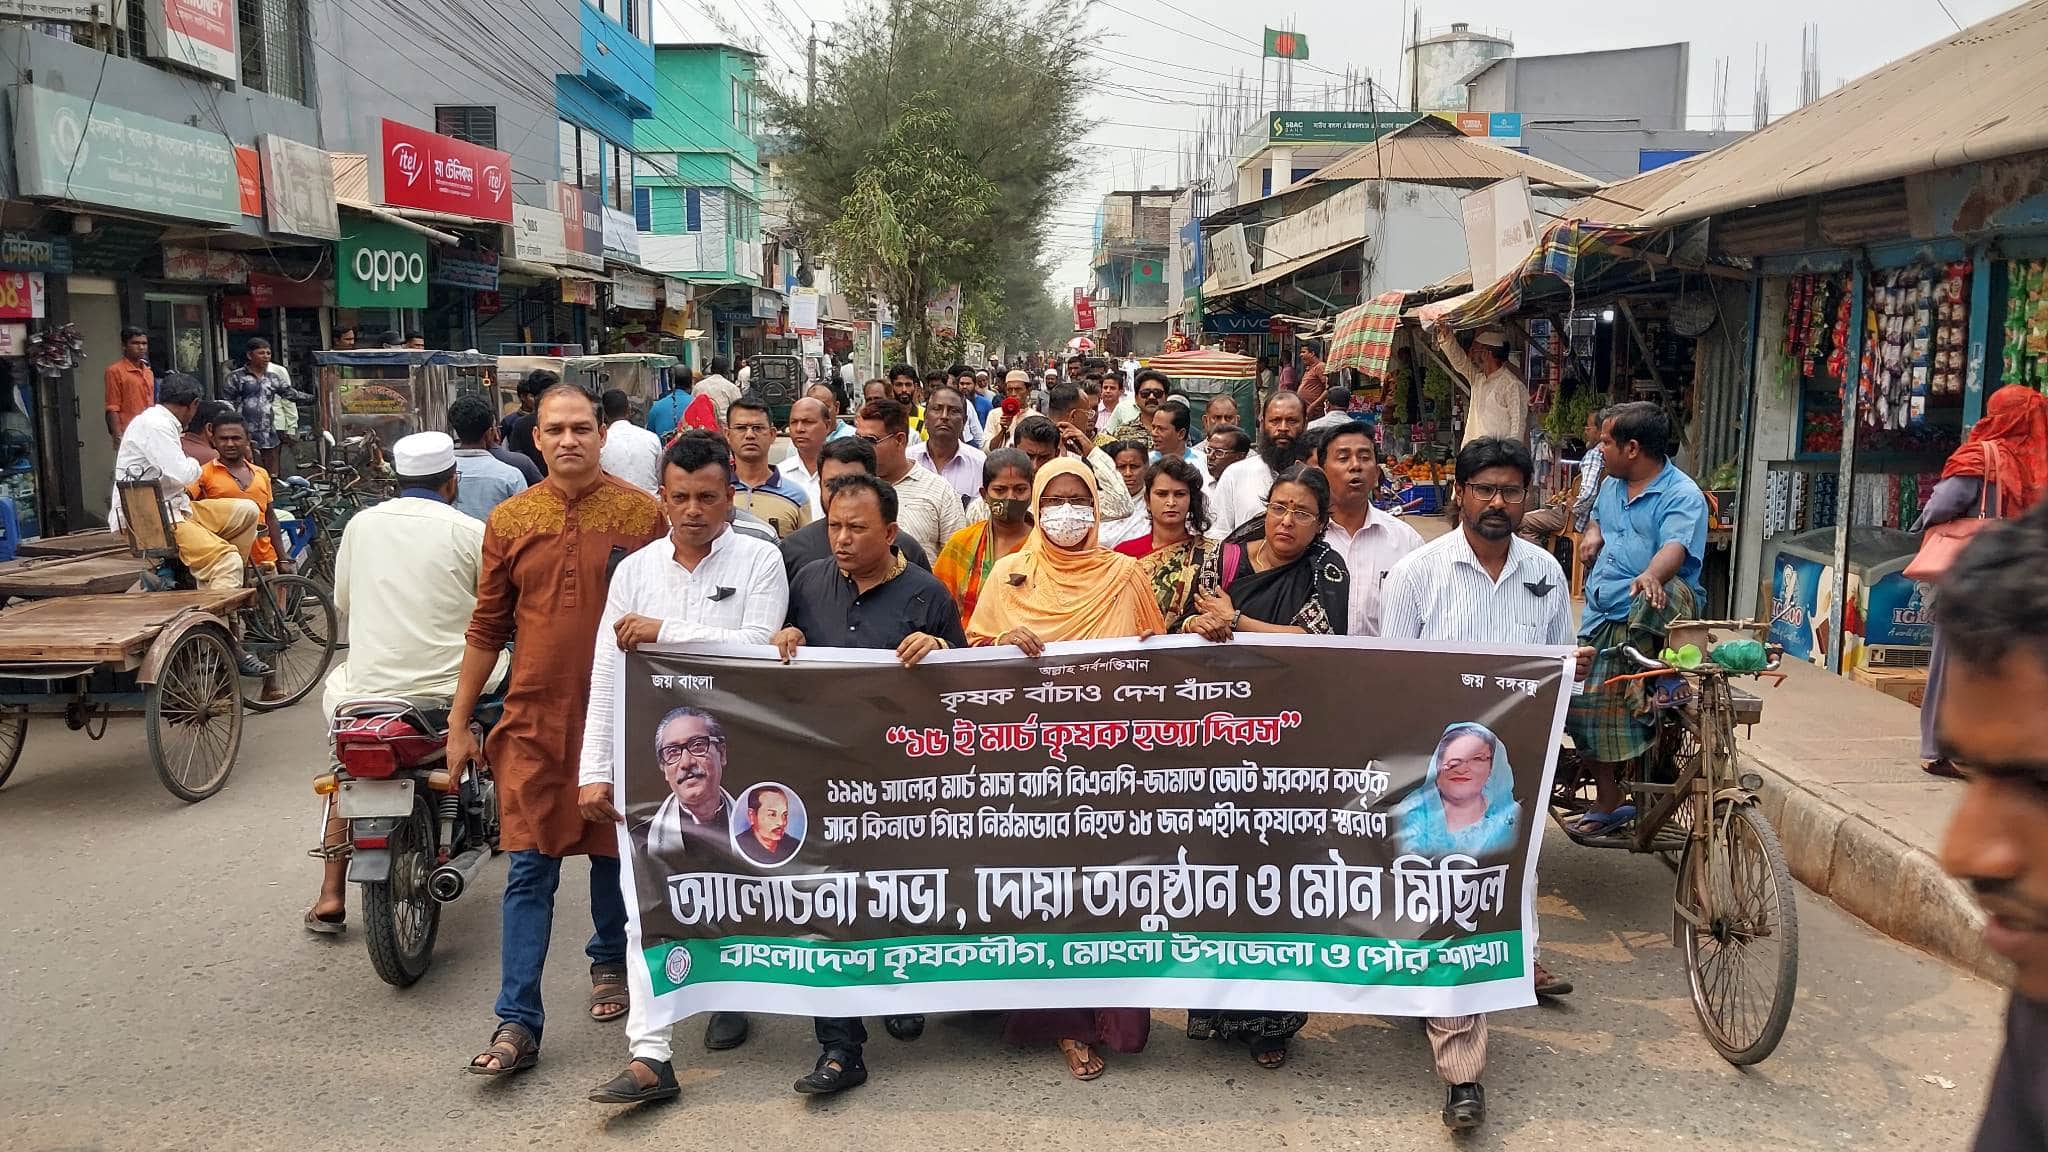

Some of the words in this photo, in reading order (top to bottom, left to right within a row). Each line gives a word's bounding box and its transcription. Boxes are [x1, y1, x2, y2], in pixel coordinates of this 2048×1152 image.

[400, 148, 417, 170] itel
[434, 159, 444, 178] মা
[445, 158, 474, 183] টেলিকম
[488, 170, 502, 189] itel
[356, 247, 424, 292] oppo
[651, 673, 673, 690] জয়
[678, 674, 713, 690] বাংলা
[940, 689, 1015, 713] কৃষক
[1023, 682, 1101, 702] বাঁচাও
[1114, 686, 1167, 702] দেশ
[1174, 678, 1251, 700] বাঁচাও
[1461, 674, 1485, 688] জয়
[1494, 675, 1540, 697] বঙ্গবন্ধু
[953, 719, 976, 755] ই
[978, 713, 1038, 751] মার্চ
[1040, 720, 1129, 762] কৃষক
[1132, 720, 1200, 751] হত্যা
[881, 777, 937, 802] সালের
[941, 765, 976, 799] মার্চ
[979, 773, 1015, 797] মাস
[1018, 766, 1063, 797] ব্যাপি
[1066, 764, 1207, 796] বিএনপি-জামাত
[1210, 760, 1259, 793] জোট
[1262, 768, 1330, 794] সরকার
[1333, 760, 1390, 809] কর্তৃক
[823, 817, 857, 843] সার
[861, 812, 927, 840] কিনতে
[929, 808, 974, 839] গিয়ে
[977, 804, 1071, 838] নির্মমভাবে
[1074, 805, 1126, 839] নিহত
[1129, 810, 1152, 835] ১৮
[1157, 809, 1194, 834] জন
[1197, 802, 1250, 838] শহীদ
[1253, 809, 1328, 845] কৃষকের
[1331, 810, 1388, 838] স্মরণে
[667, 872, 860, 926] আলোচনা
[866, 868, 949, 924] সভা
[975, 867, 1076, 922] দোয়া
[1082, 845, 1238, 932] অনুষ্ঠান
[1247, 865, 1280, 915] ও
[1290, 849, 1383, 924] মৌন
[1392, 853, 1509, 932] মিছিল
[720, 944, 877, 972] বাংলাদেশ
[1063, 940, 1165, 965] মোংলা
[1170, 933, 1315, 965] উপজেলা
[1321, 944, 1349, 967] ও
[1357, 934, 1430, 973] পৌর
